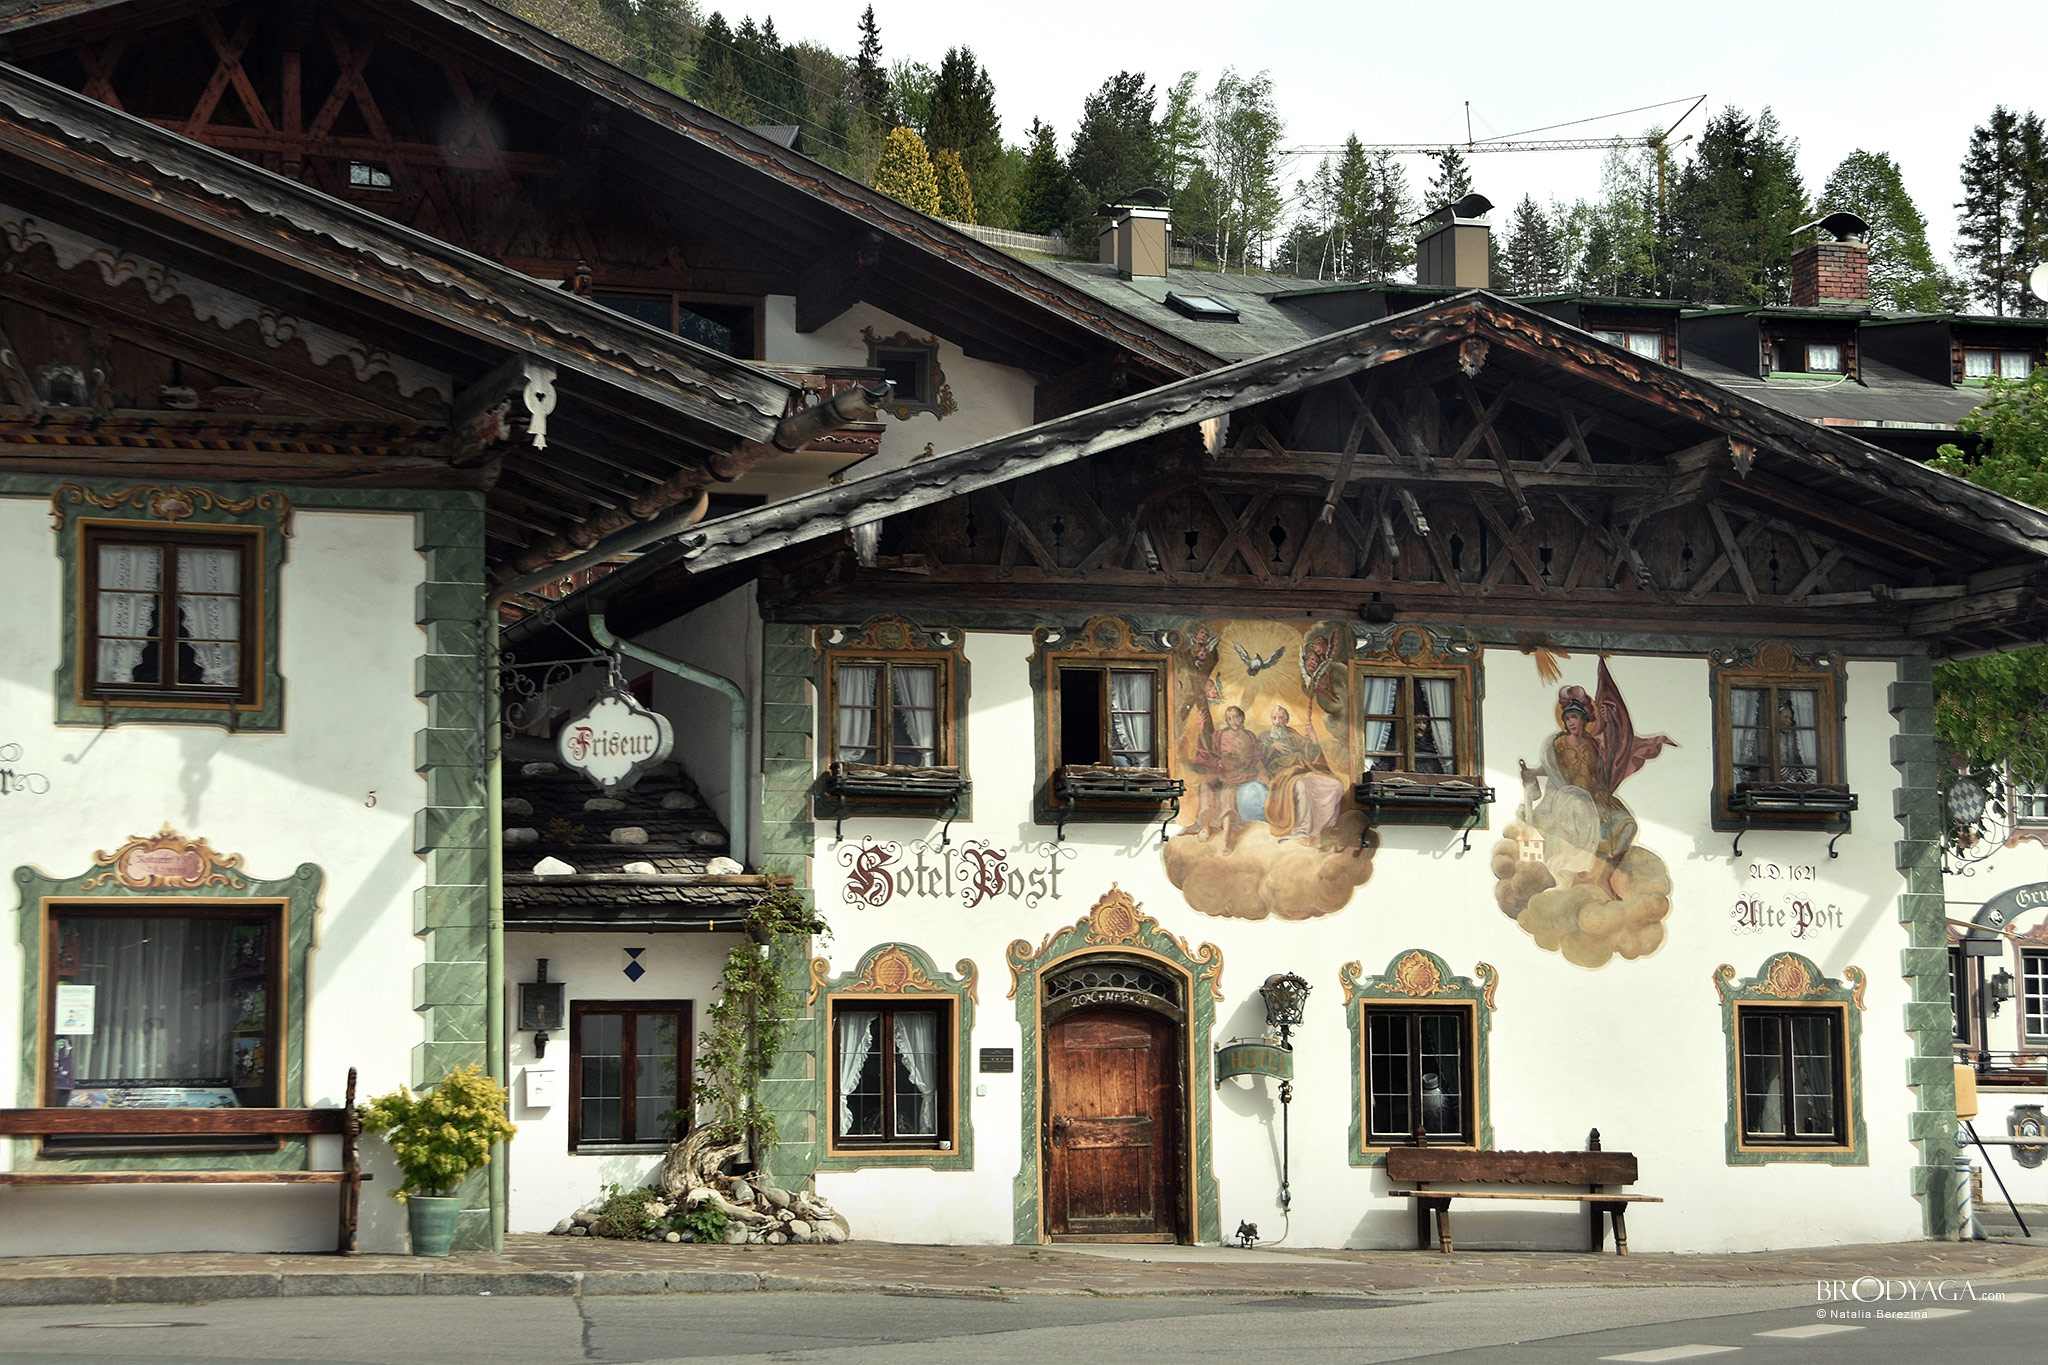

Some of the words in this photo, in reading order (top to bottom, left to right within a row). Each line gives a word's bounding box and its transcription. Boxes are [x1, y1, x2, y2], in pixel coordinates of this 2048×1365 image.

[568, 726, 653, 761] Friseur
[364, 790, 378, 808] 5
[837, 835, 958, 910] Hotel
[956, 839, 1078, 909] Post
[1788, 864, 1816, 881] 1621
[1730, 895, 1786, 933] Alte
[1231, 1049, 1289, 1075] HOTEL
